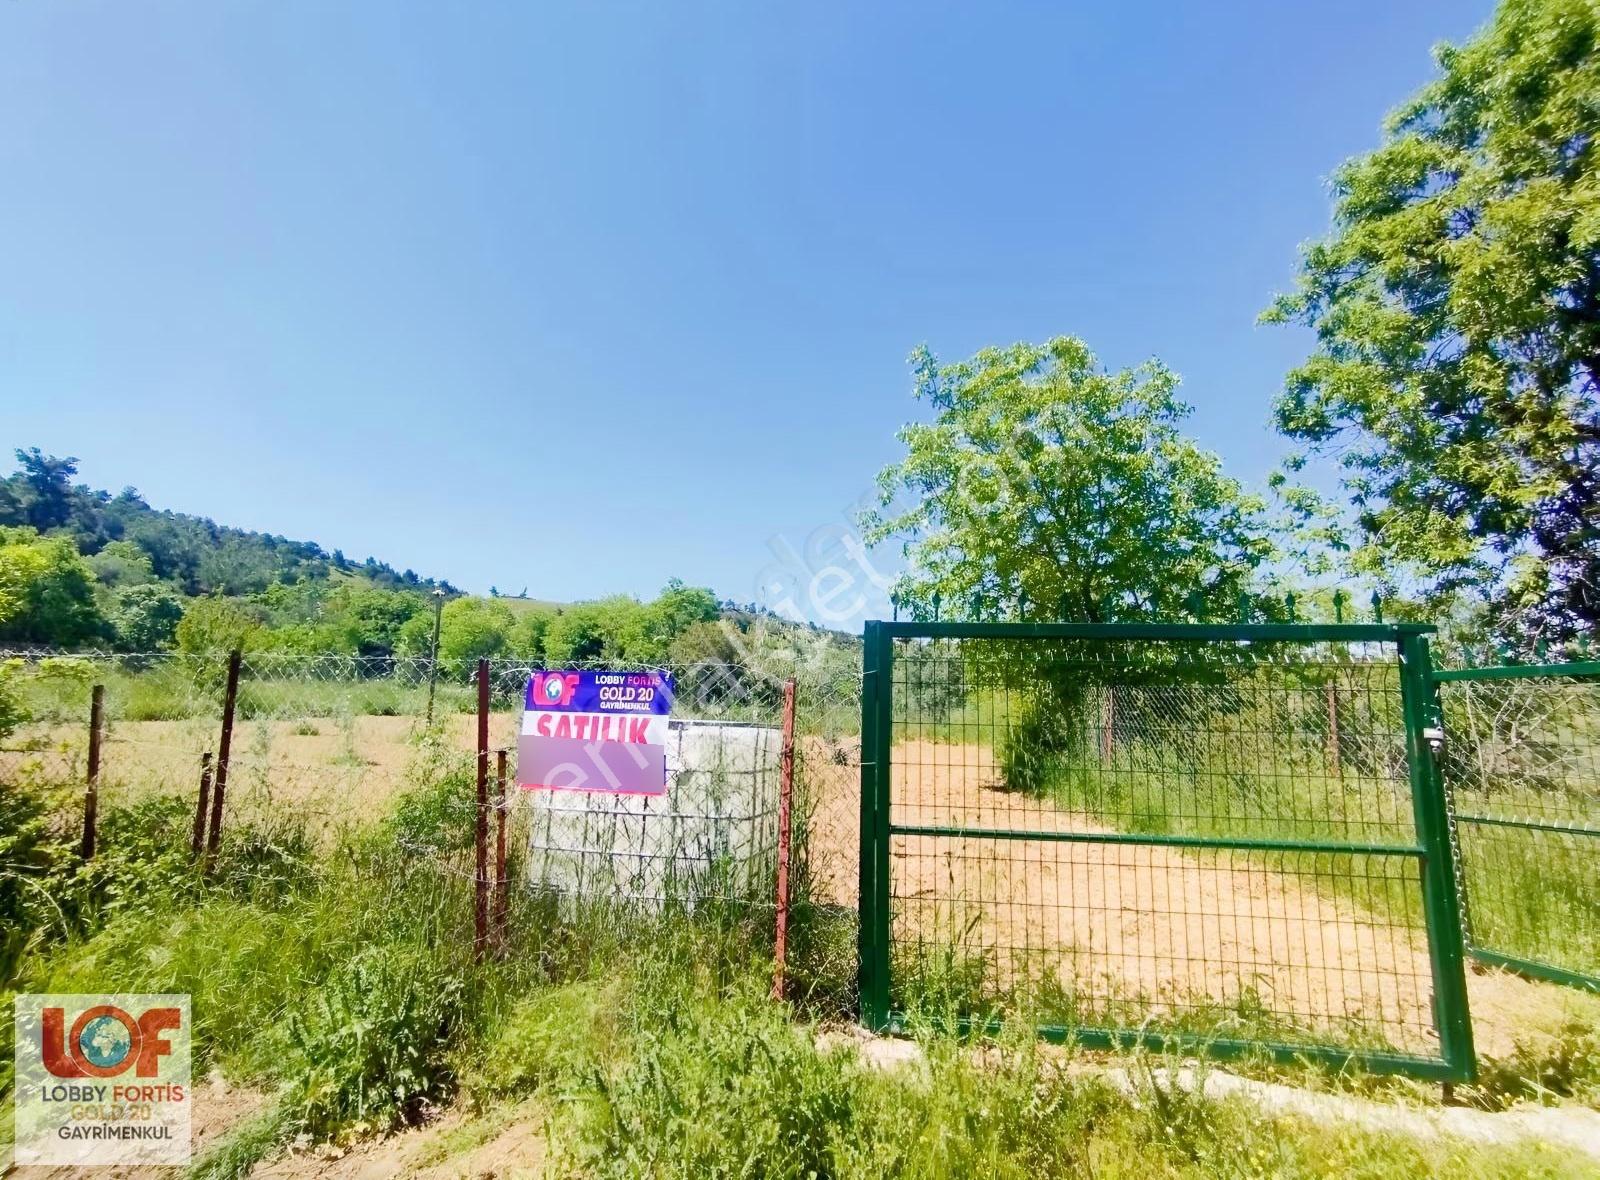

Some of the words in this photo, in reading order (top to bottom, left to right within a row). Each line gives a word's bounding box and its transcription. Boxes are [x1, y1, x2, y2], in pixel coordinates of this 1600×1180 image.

[595, 674, 626, 685] LOBBY
[599, 686, 636, 701] GOLD
[637, 687, 654, 701] 20
[537, 713, 653, 745] SATILIK
